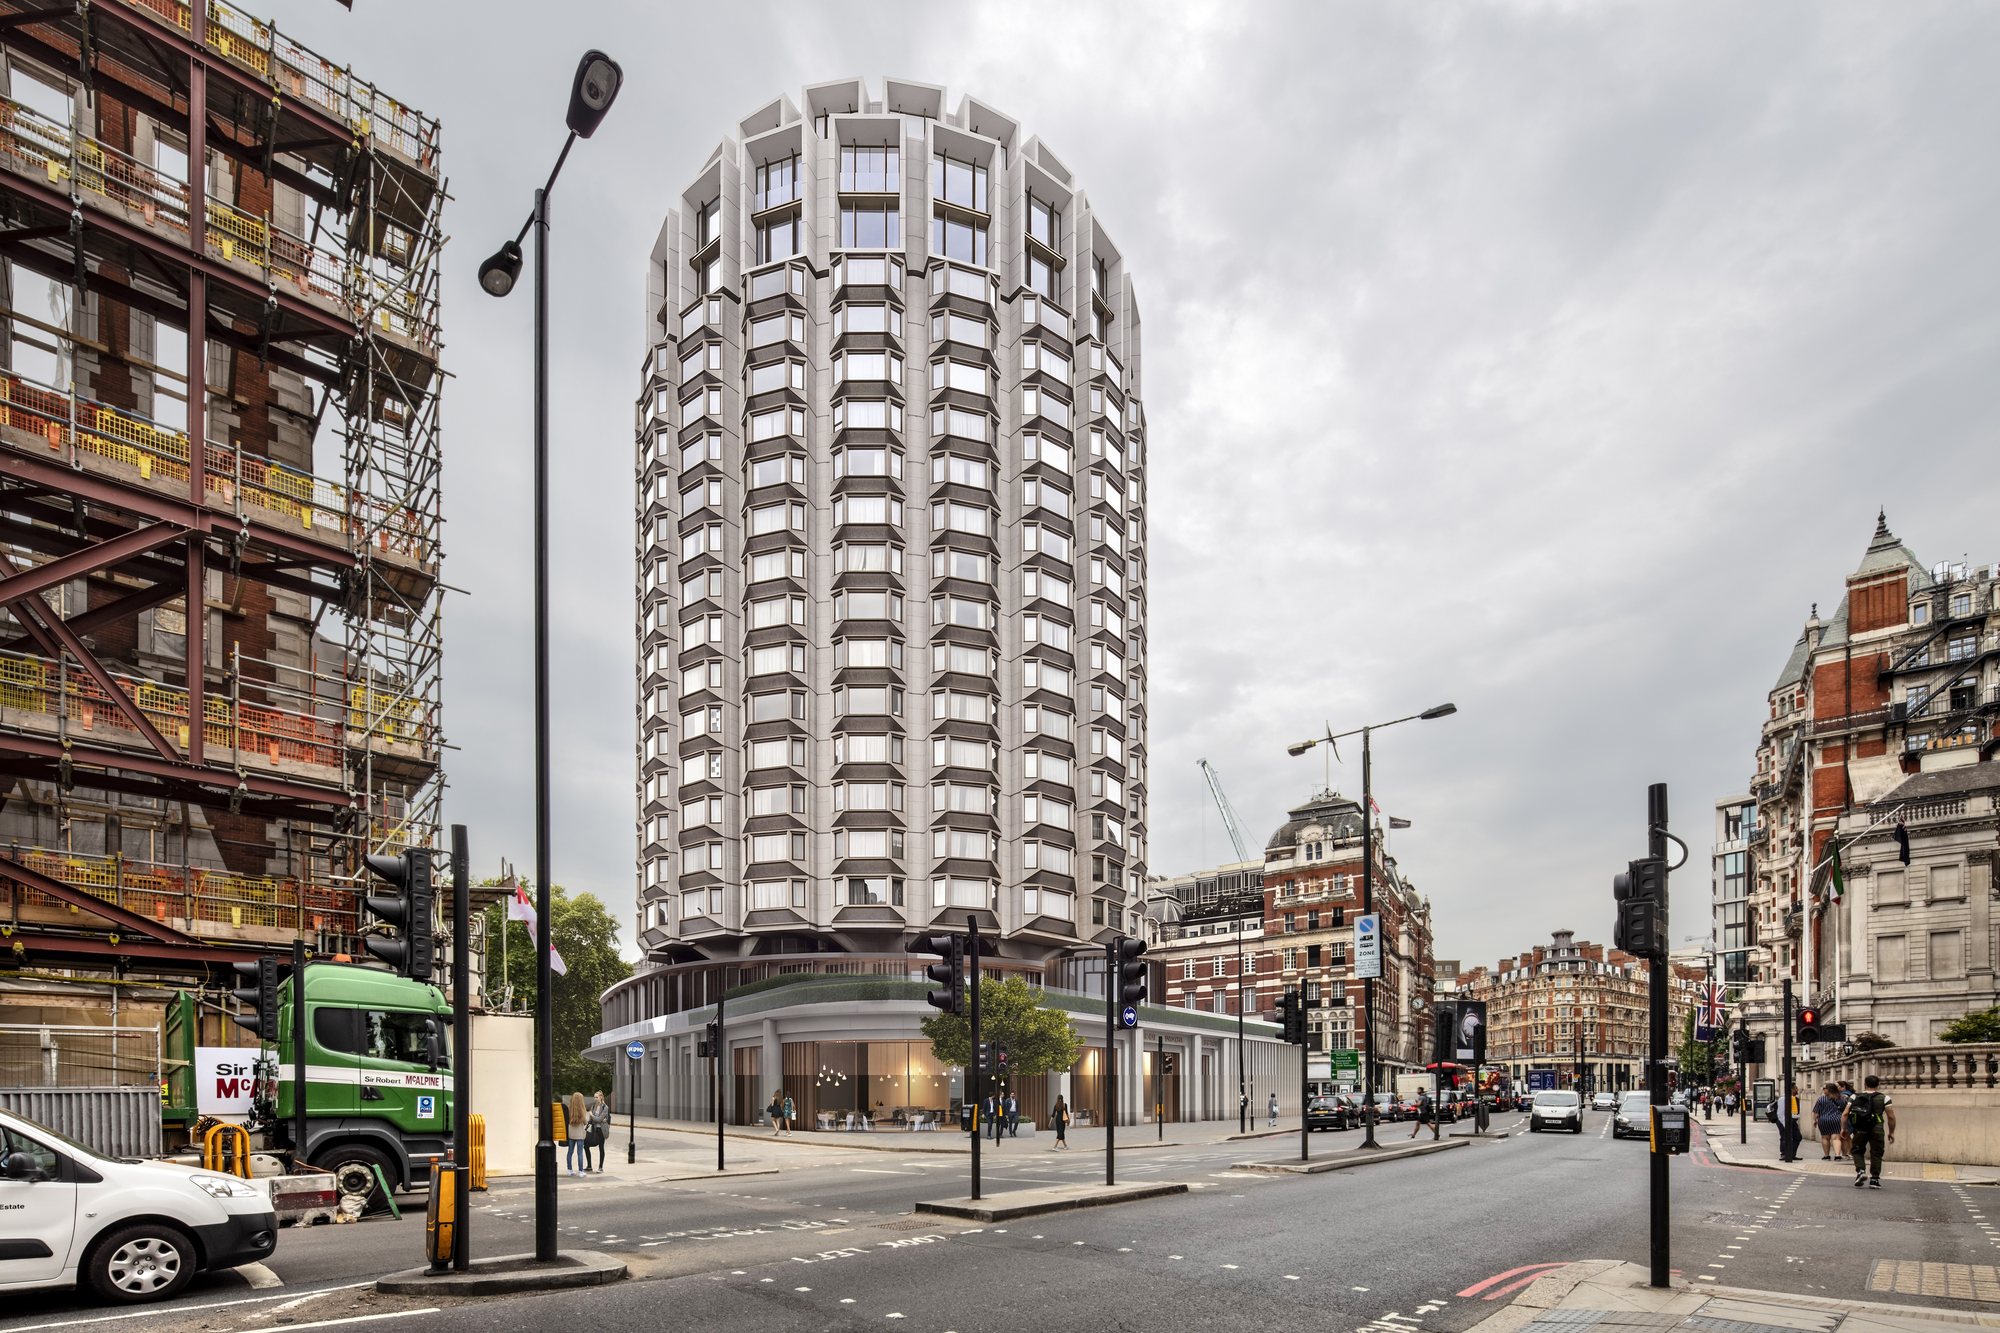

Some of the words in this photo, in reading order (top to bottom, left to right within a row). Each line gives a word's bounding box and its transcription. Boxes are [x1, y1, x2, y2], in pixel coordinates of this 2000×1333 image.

[216, 1063, 238, 1076] Sir
[375, 1077, 401, 1085] Robert
[877, 1234, 946, 1248] LOOK
[791, 1247, 871, 1264] LEFT
